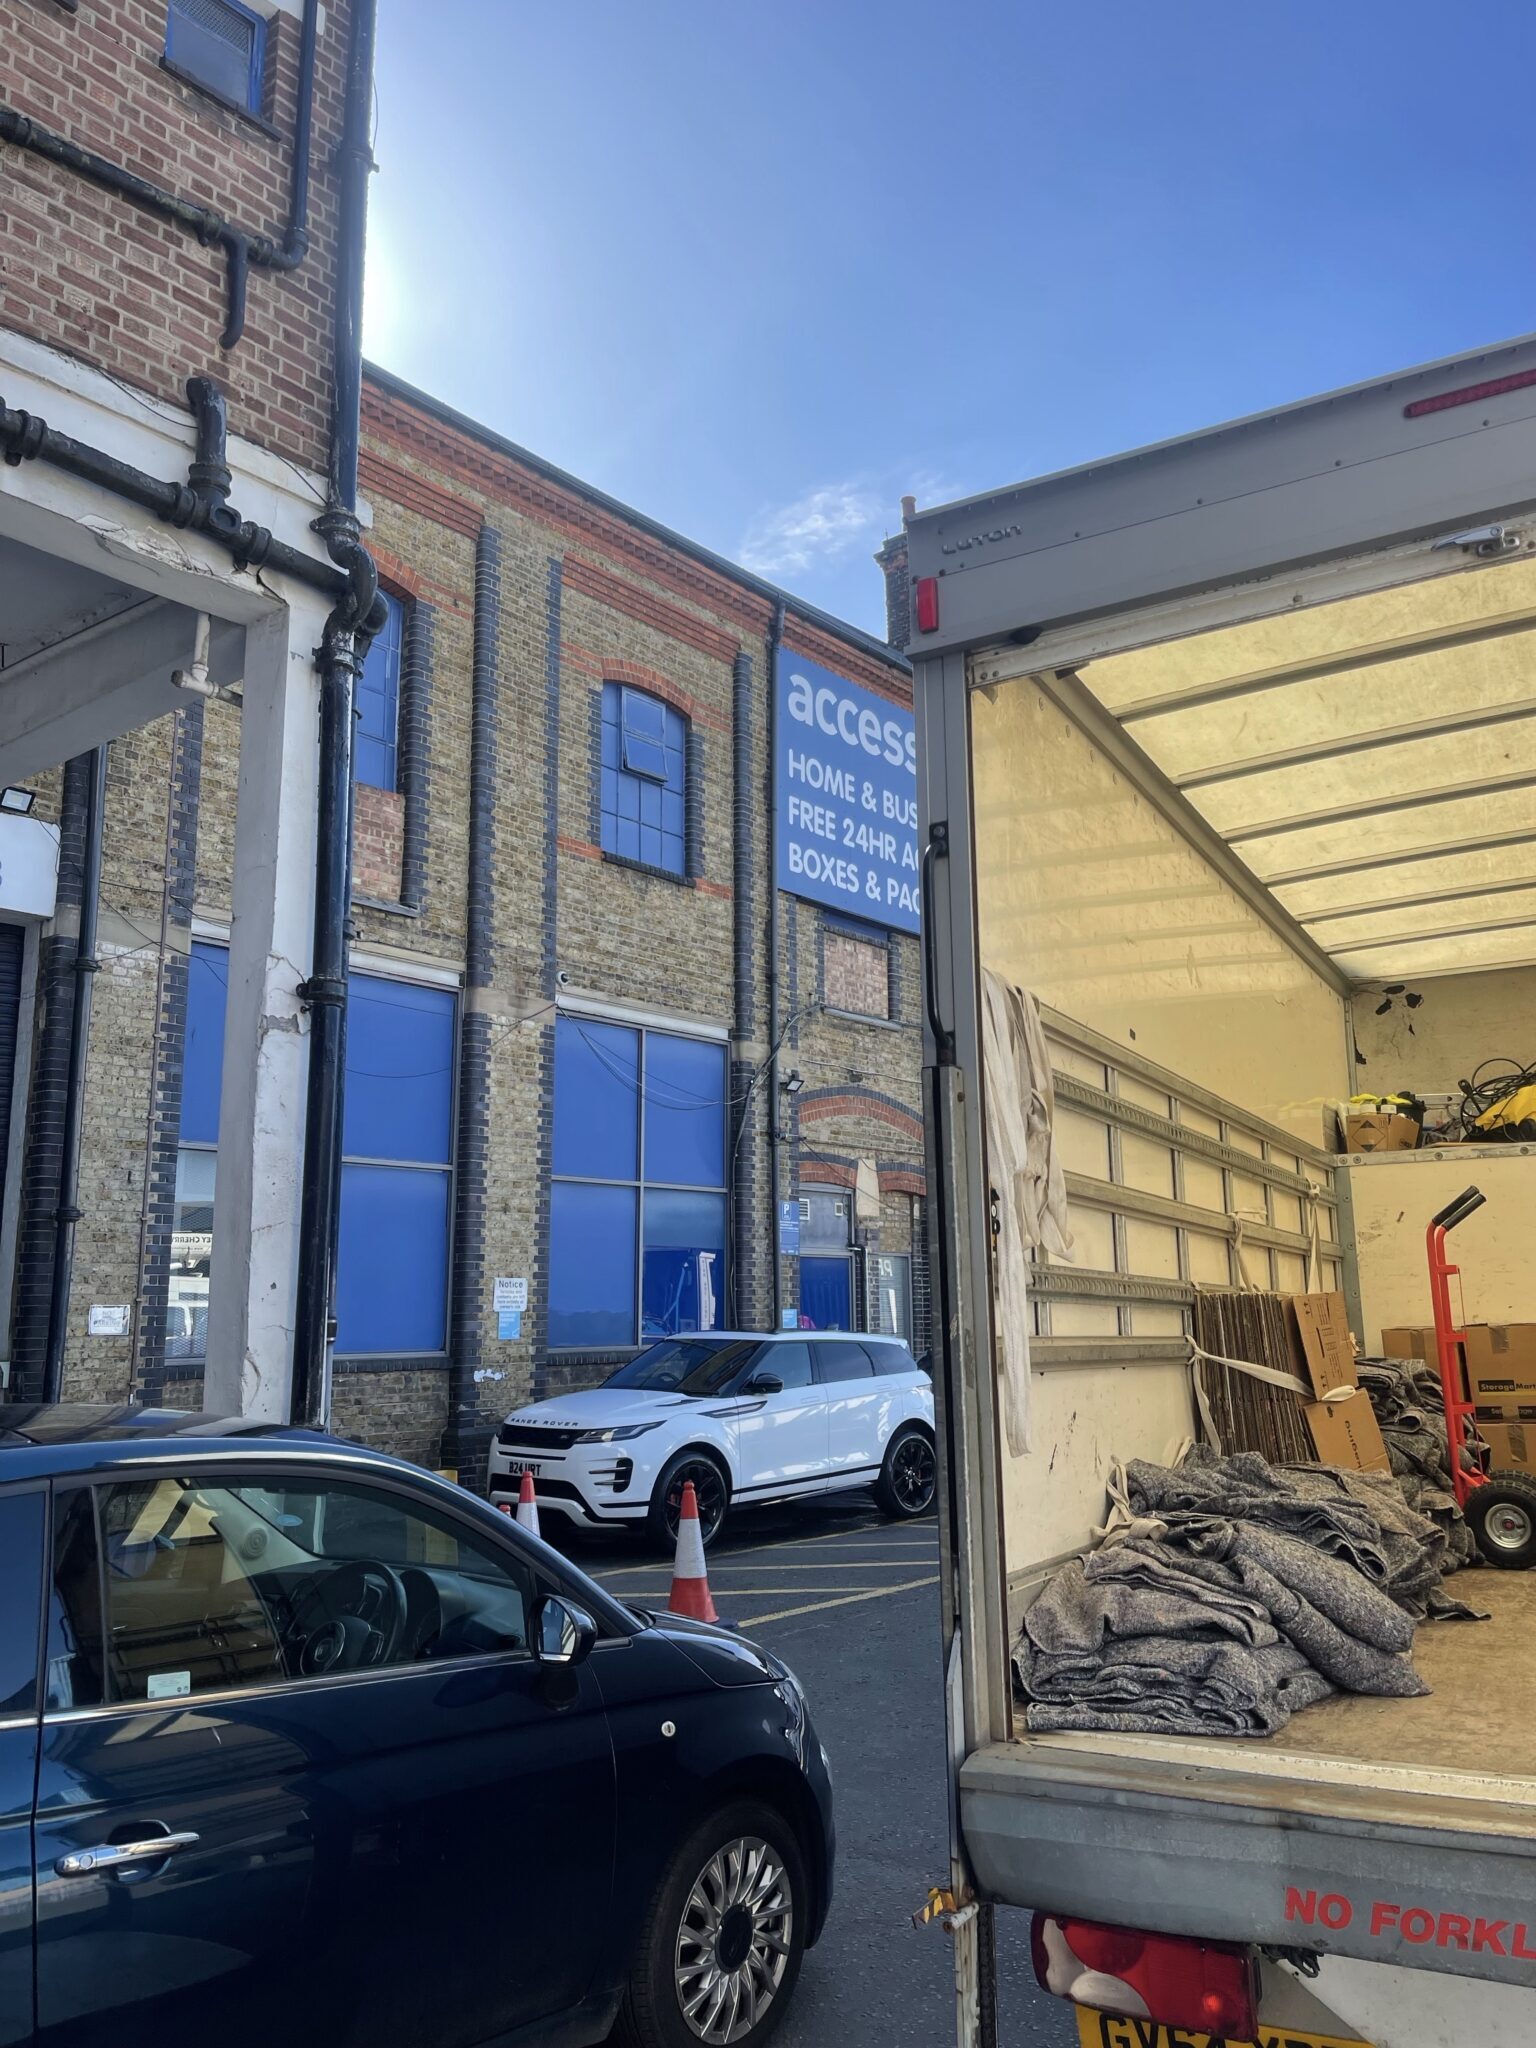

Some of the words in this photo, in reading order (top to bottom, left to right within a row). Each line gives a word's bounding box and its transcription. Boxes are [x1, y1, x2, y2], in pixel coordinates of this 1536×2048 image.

[788, 748, 855, 804] HOME
[861, 781, 877, 812] &
[882, 790, 918, 830] BUS
[788, 796, 836, 840] FREE
[842, 818, 897, 864] 24HR
[788, 842, 860, 893] BOXES
[865, 870, 881, 902] &
[783, 1203, 790, 1215] P
[499, 1280, 523, 1288] Notice
[1283, 1886, 1353, 1930] NO
[1369, 1901, 1536, 1960] FORKL
